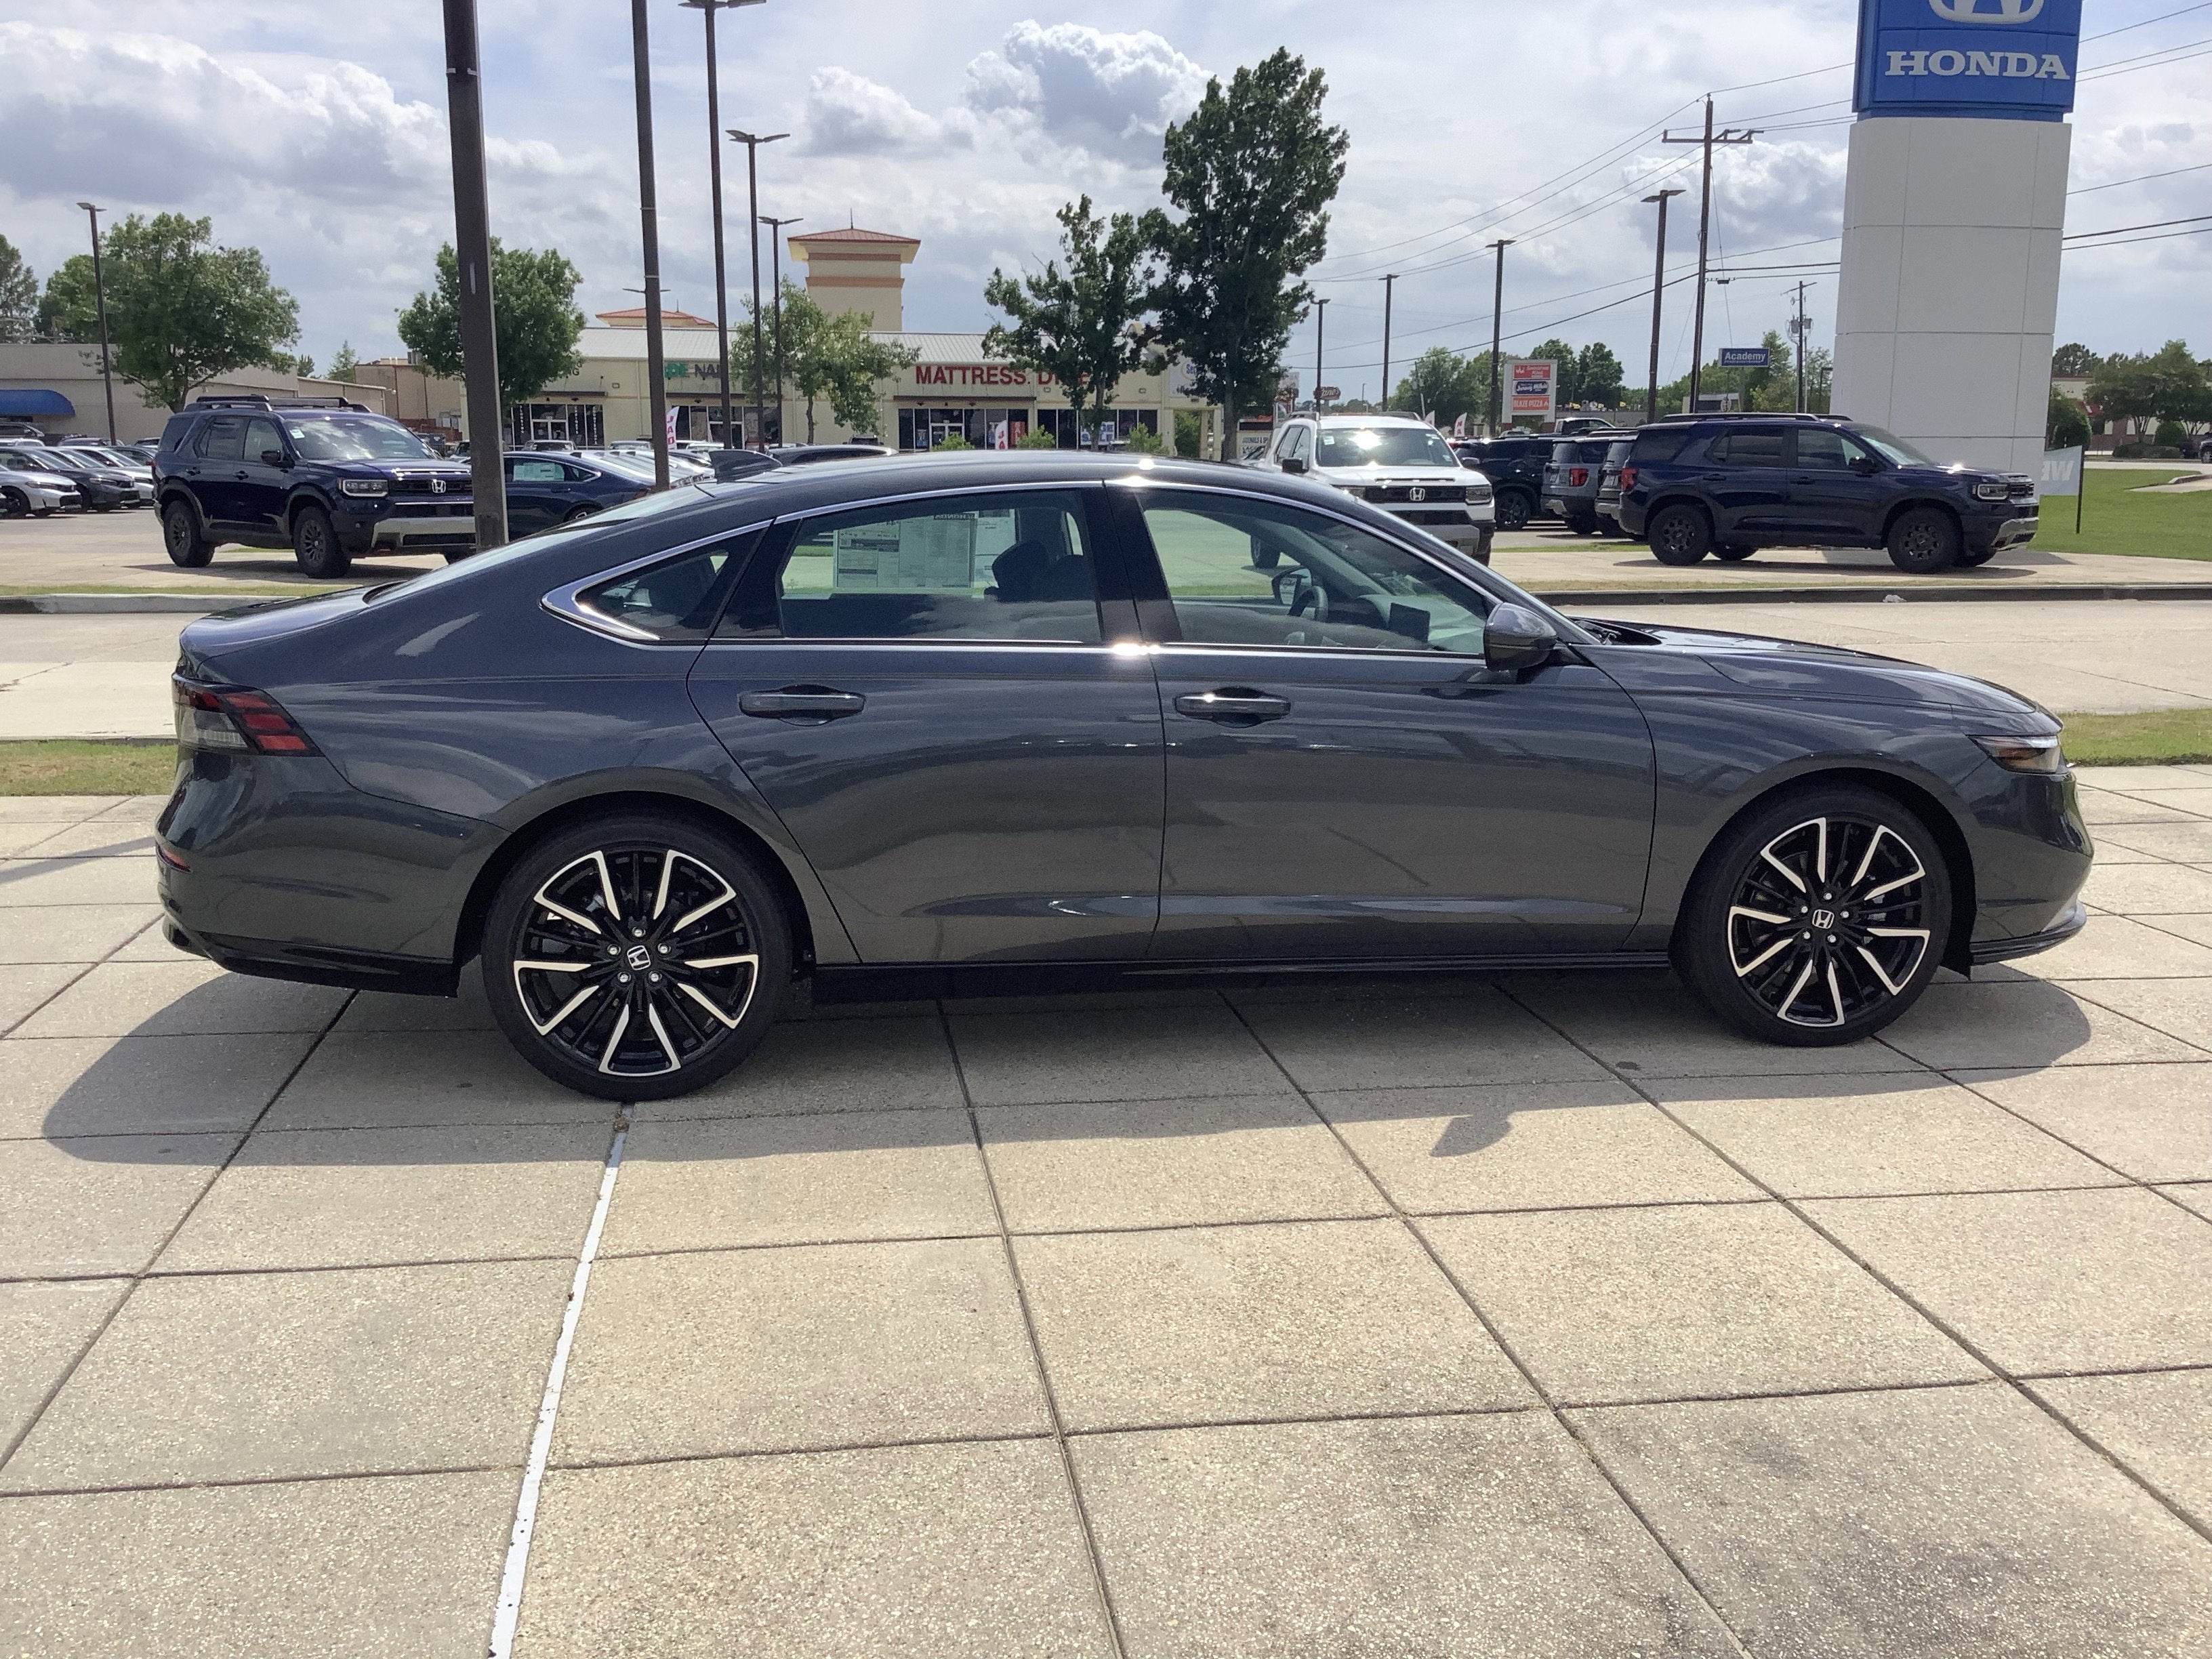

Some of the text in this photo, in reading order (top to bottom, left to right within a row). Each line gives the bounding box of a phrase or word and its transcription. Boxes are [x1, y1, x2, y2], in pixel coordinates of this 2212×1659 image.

[1885, 49, 2070, 80] HONDA
[1724, 352, 1766, 363] Academy
[915, 366, 1027, 386] MATTRESS
